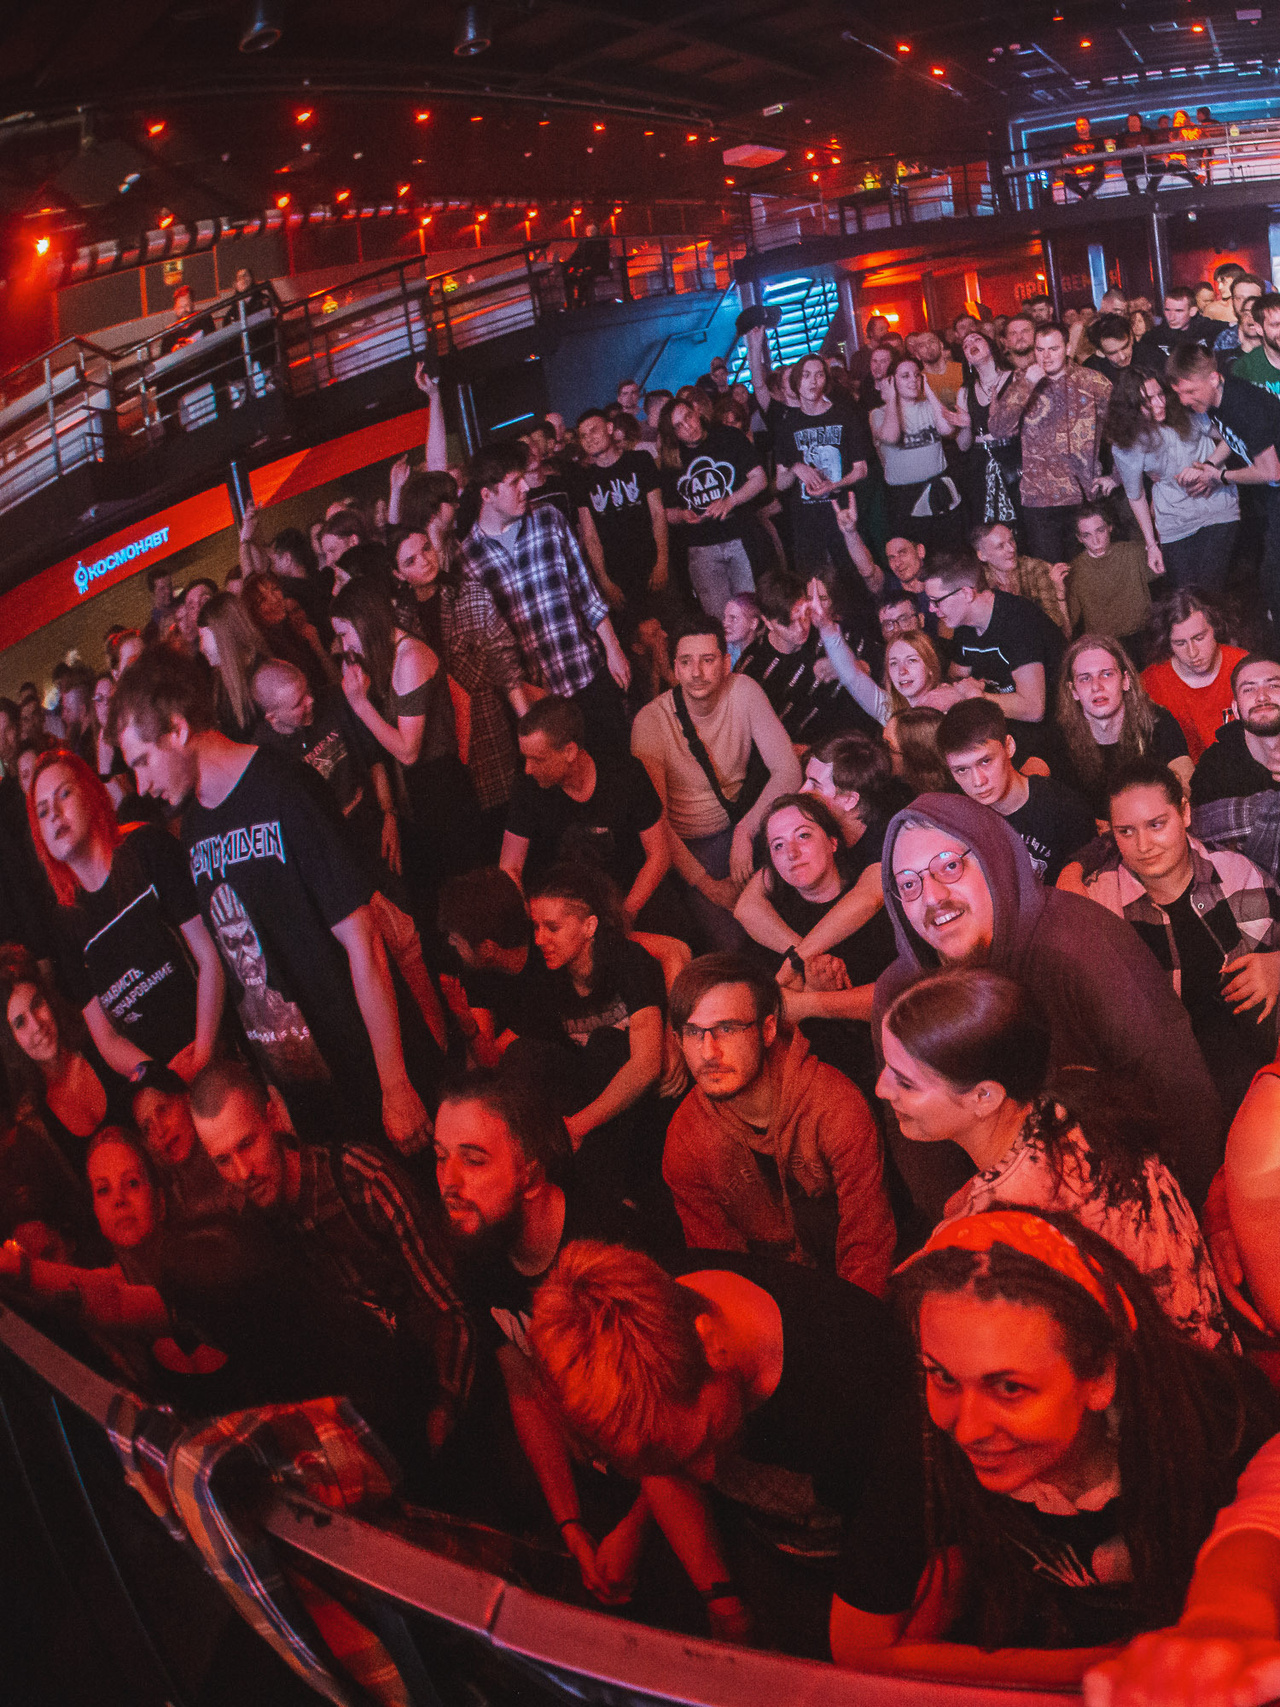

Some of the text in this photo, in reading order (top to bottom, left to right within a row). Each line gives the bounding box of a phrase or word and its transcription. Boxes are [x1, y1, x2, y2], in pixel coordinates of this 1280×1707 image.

[692, 471, 719, 494] АД
[693, 488, 722, 505] НАШ
[86, 526, 169, 581] КОСМОНАВТ
